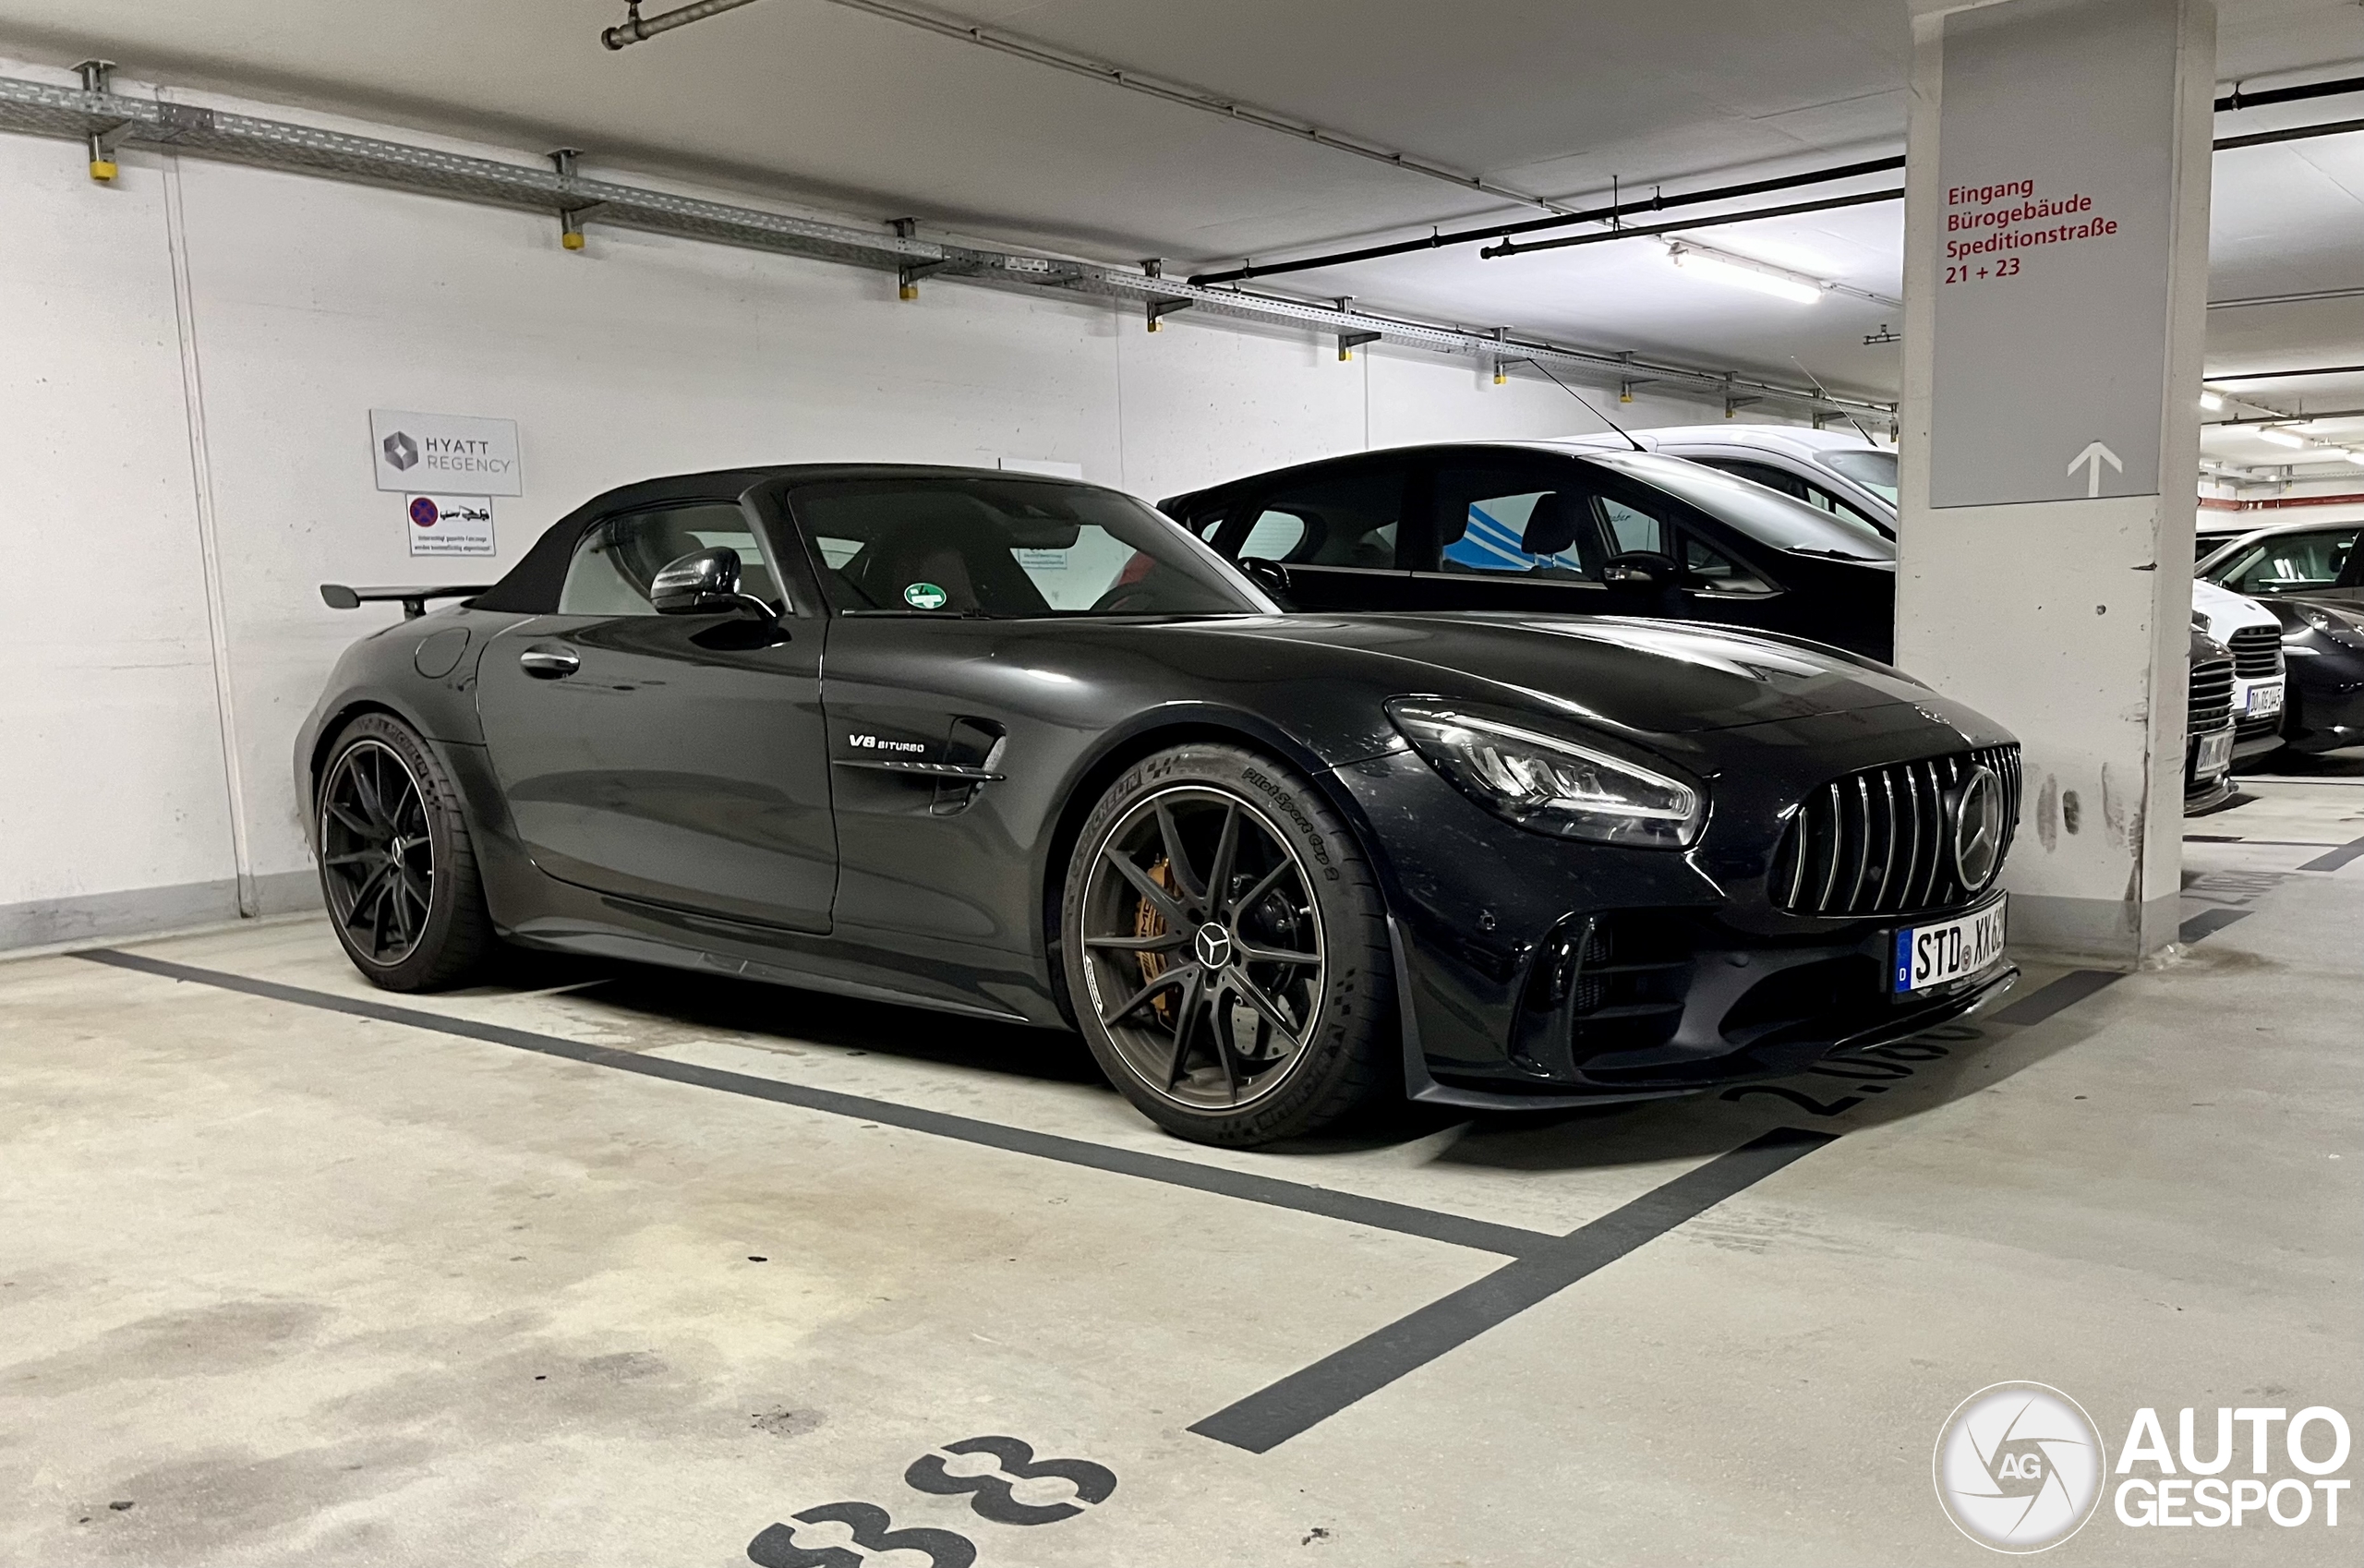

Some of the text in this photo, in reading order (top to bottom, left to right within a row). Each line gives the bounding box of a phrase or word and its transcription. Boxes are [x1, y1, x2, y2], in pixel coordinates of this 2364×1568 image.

[1948, 179, 2033, 205] Eingang
[1948, 194, 2092, 232] Bürogebäude
[1947, 217, 2117, 260] Speditionstraße
[1946, 258, 2020, 283] 21 + 23
[426, 437, 488, 454] HYATT
[427, 455, 511, 473] REGENCY
[849, 734, 924, 753] V8 BITURBO
[1242, 767, 1281, 796] Pilot
[1274, 792, 1314, 834] Sport
[1309, 833, 1329, 865] Cup
[1915, 926, 1960, 980] STD
